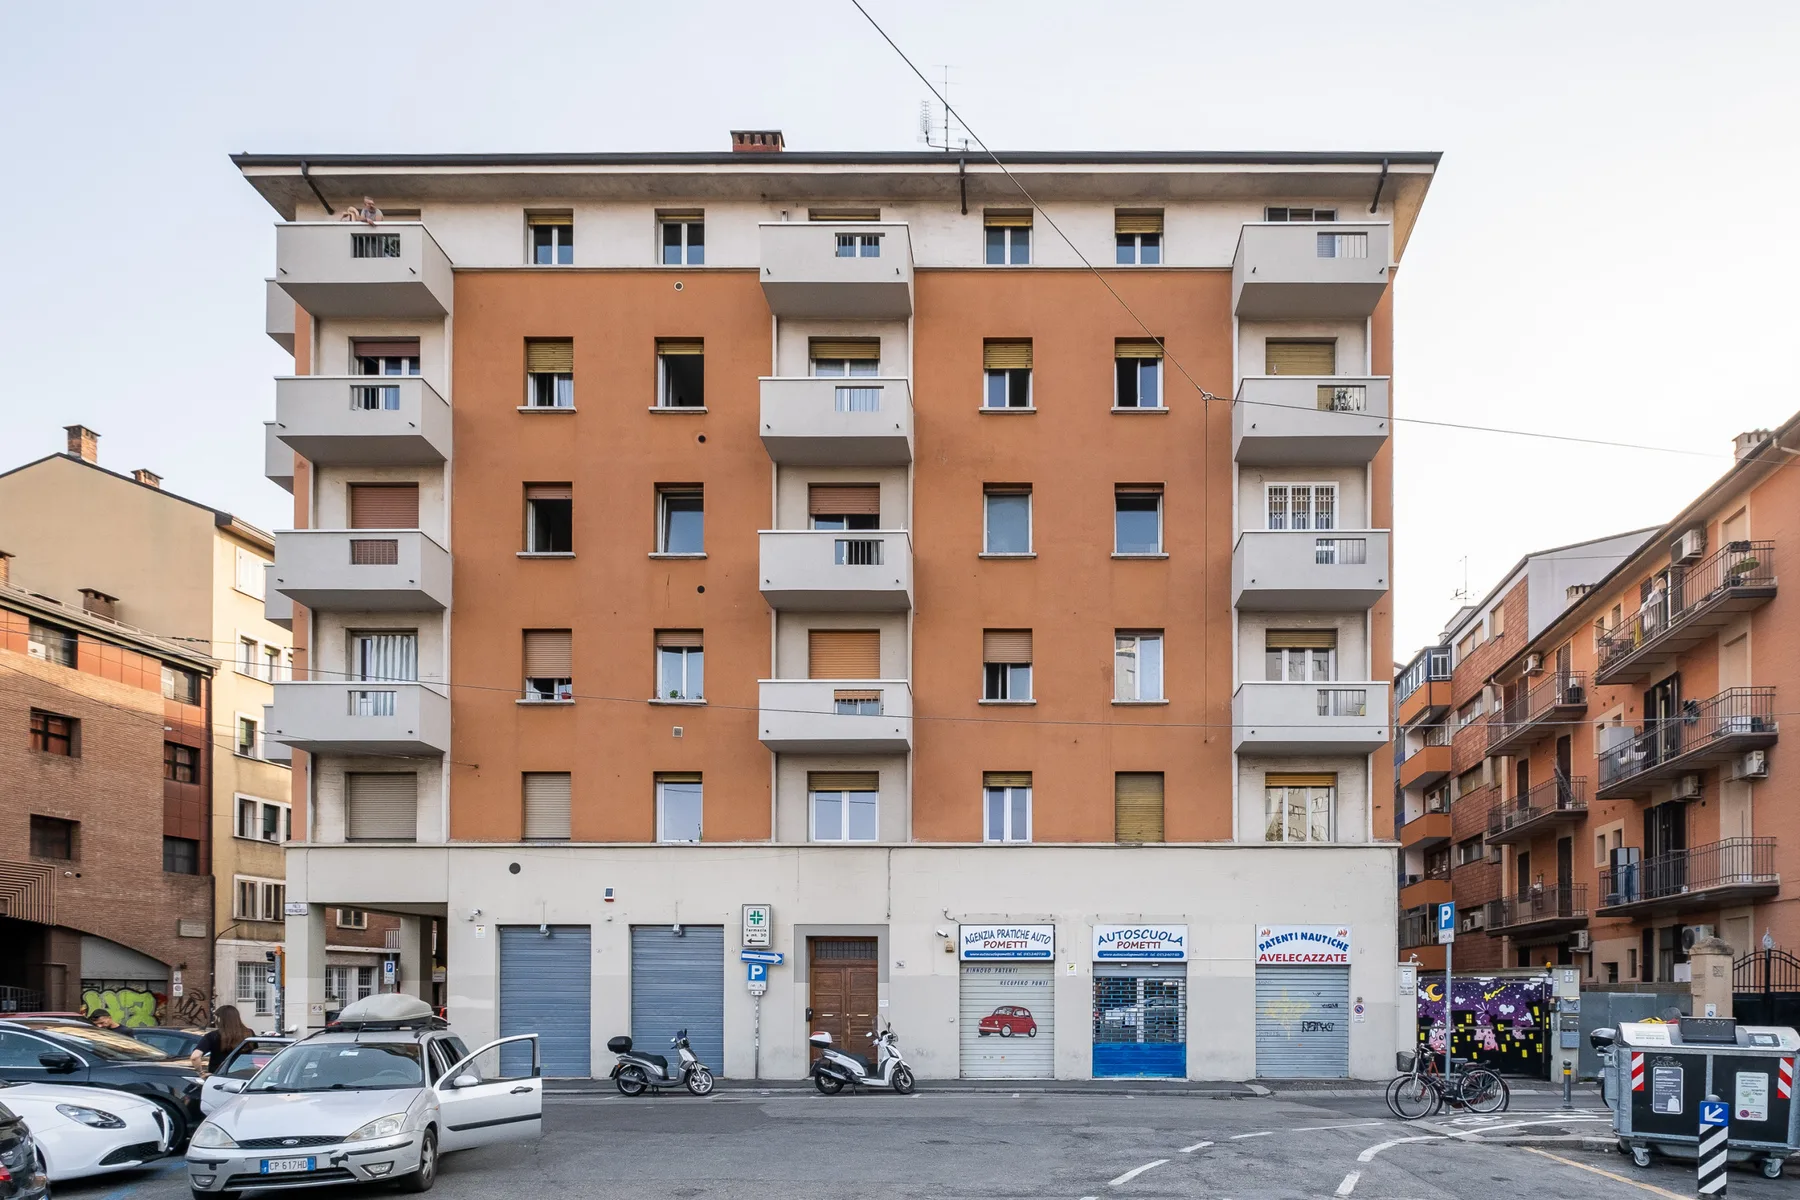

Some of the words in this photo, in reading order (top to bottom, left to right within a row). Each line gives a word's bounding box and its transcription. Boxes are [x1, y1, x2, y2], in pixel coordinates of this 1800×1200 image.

[1442, 906, 1451, 928] P
[965, 930, 995, 945] AGENZIA
[997, 929, 1030, 940] PRATICHE
[1031, 932, 1051, 945] AUTO
[984, 940, 1028, 948] POMETTI
[1098, 929, 1182, 946] AUTOSCUOLA
[1258, 932, 1299, 952] PATENTI
[1300, 932, 1349, 952] NAUTICHE
[1259, 953, 1347, 963] AVELECAZZATE
[751, 965, 763, 980] P
[270, 1162, 280, 1170] CP
[282, 1160, 307, 1170] 617HD
